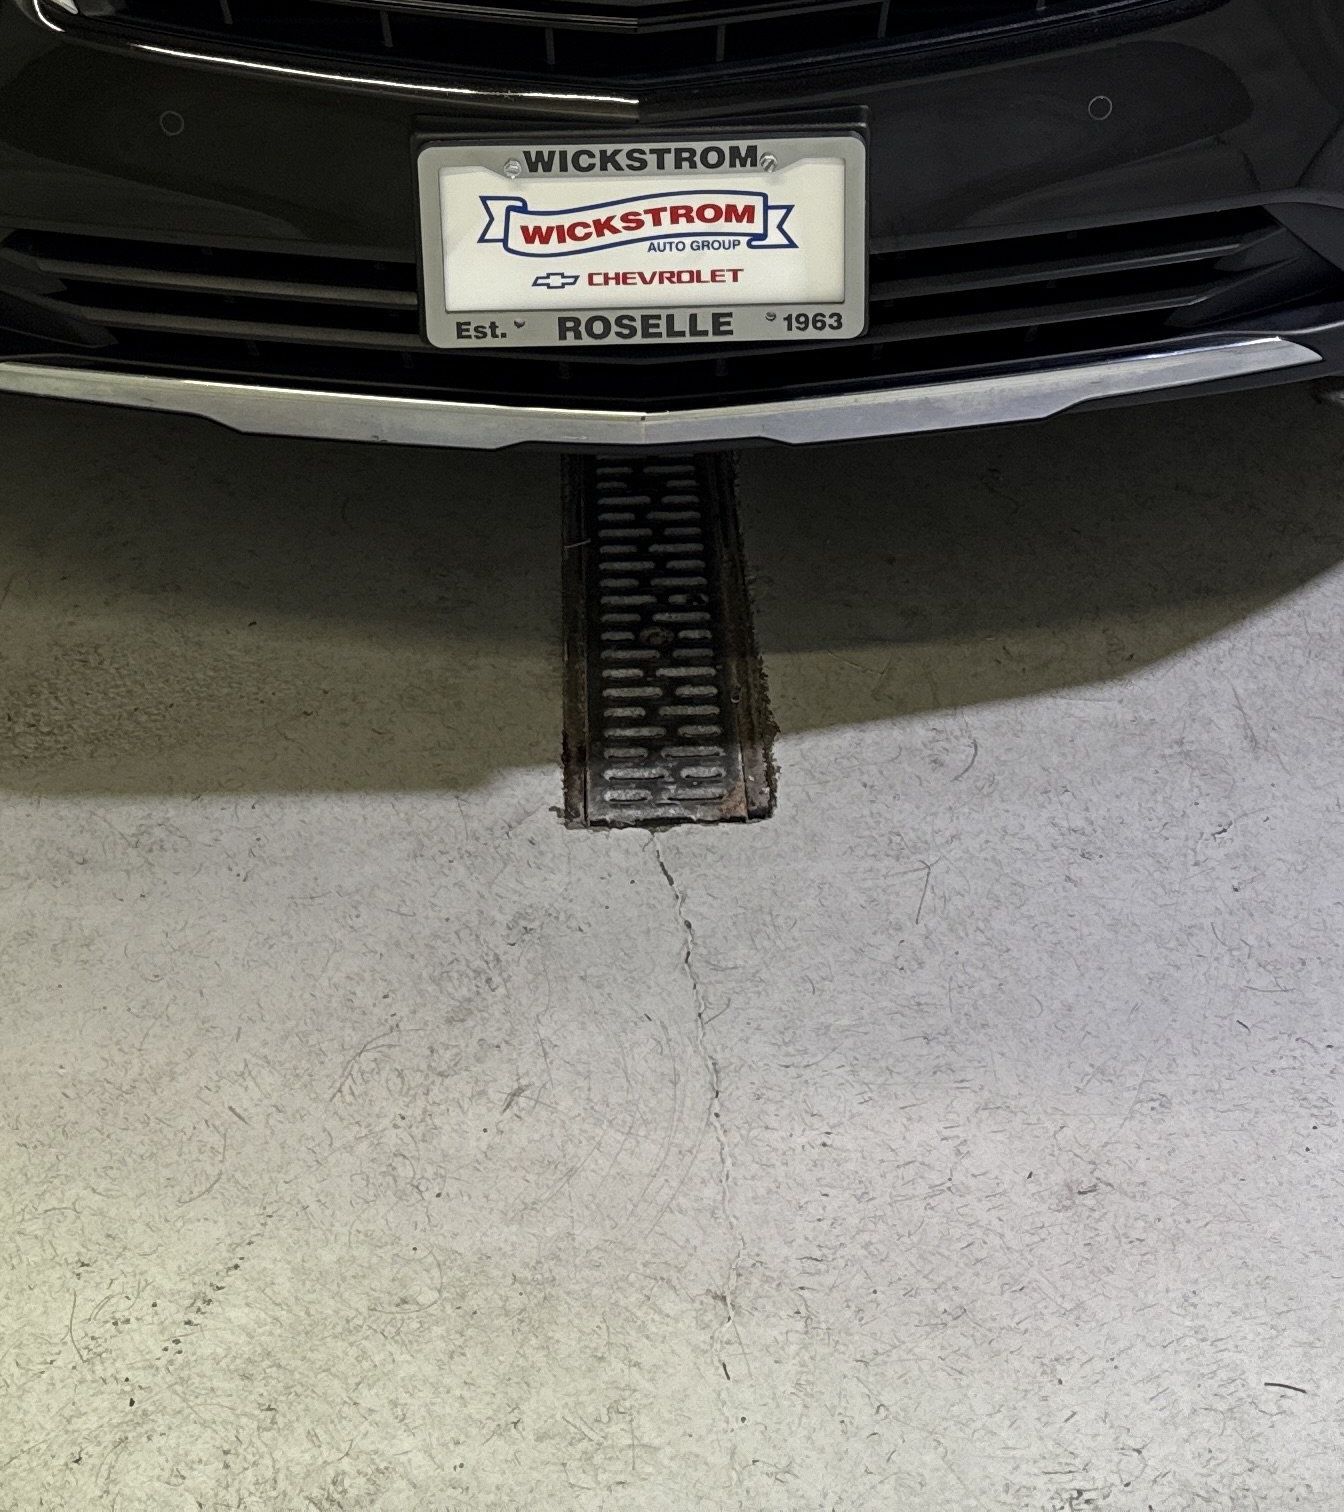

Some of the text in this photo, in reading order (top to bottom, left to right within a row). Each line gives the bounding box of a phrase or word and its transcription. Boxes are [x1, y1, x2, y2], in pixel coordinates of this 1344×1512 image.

[523, 144, 759, 174] WICKSTROM
[520, 203, 756, 246] WICKSTROM
[647, 238, 742, 254] AUTO GROUP
[587, 268, 744, 287] CHEVROLET
[455, 311, 843, 342] Est. ROSELLE 1963
